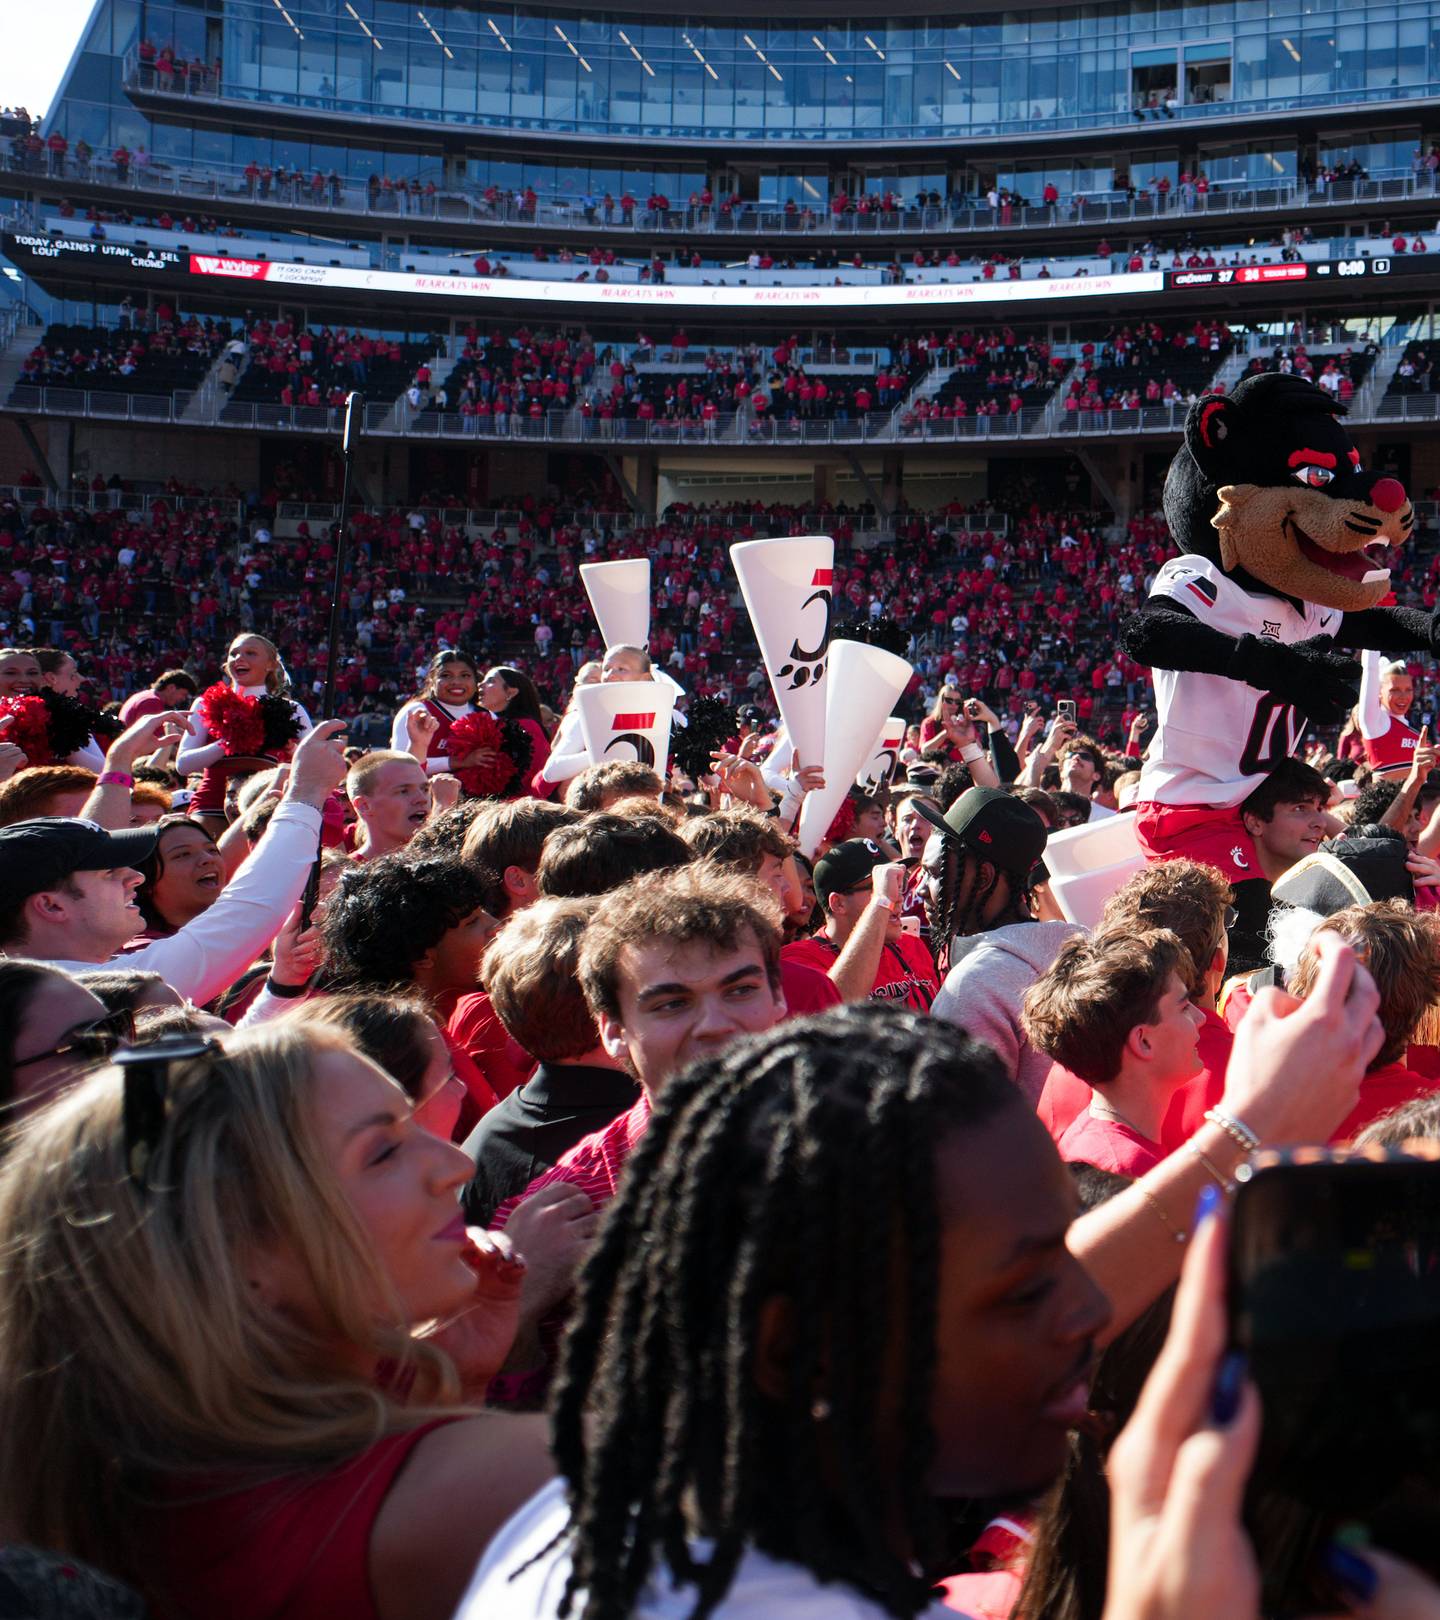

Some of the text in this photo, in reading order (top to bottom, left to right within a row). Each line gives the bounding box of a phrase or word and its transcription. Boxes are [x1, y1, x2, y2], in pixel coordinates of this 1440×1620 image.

[32, 246, 165, 269] LOUT CROWD
[101, 245, 135, 257] UTAH.
[147, 250, 155, 260] A
[160, 253, 180, 262] SEL
[1337, 261, 1365, 276] 0:00
[1218, 270, 1233, 282] 37
[415, 278, 491, 291] BEARCATS WIN
[1048, 280, 1112, 293] BEARCATS WIN
[601, 288, 674, 299] BEARCATS WIN
[754, 292, 820, 300] BEARCATS WIN
[906, 288, 974, 298] BEARCATS WIN
